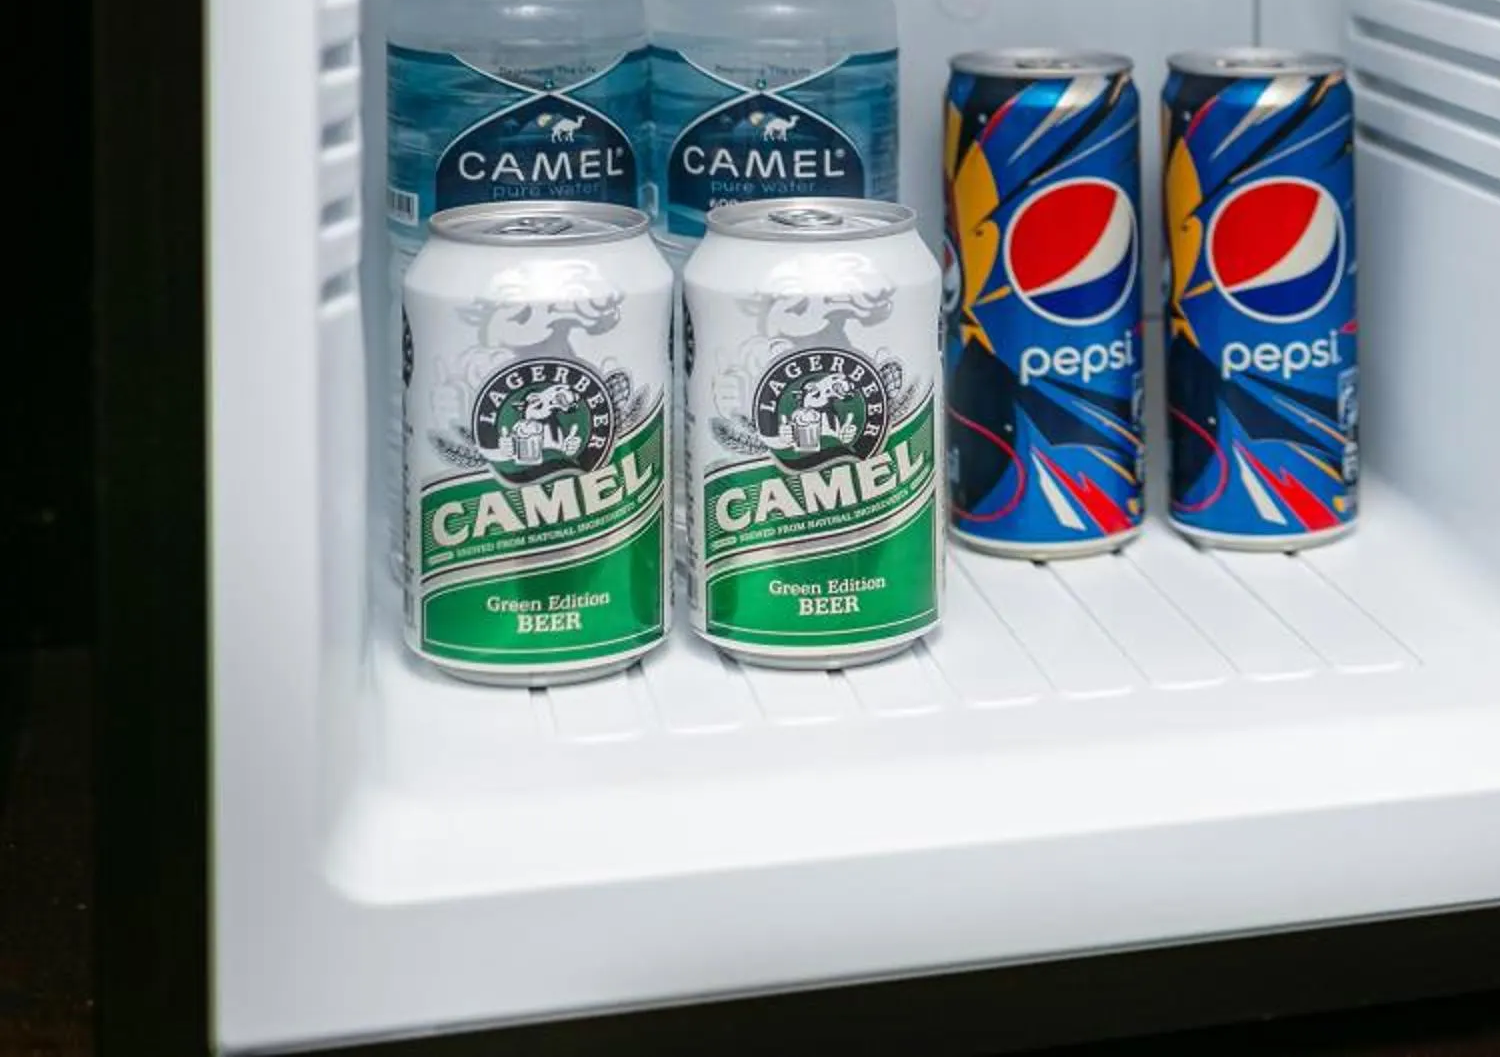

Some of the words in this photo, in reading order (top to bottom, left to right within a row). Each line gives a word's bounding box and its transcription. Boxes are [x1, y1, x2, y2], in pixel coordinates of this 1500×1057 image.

[458, 147, 624, 182] CAMEL
[683, 146, 845, 179] CAMEL
[493, 185, 541, 200] pure
[548, 182, 600, 197] water
[711, 181, 755, 194] pure
[761, 180, 816, 193] water
[1019, 329, 1134, 386] pepsi
[1221, 328, 1340, 381] pepsi
[715, 441, 925, 532] CAMEL
[431, 452, 653, 547] CAMEL
[777, 522, 806, 536] FROM
[807, 514, 853, 529] NATURAL
[527, 528, 576, 545] NATURAL
[768, 580, 822, 597] Green
[827, 576, 887, 595] Edition
[486, 595, 542, 612] Green
[548, 590, 610, 611] Edition
[799, 596, 861, 617] BEER
[517, 611, 583, 634] BEER
